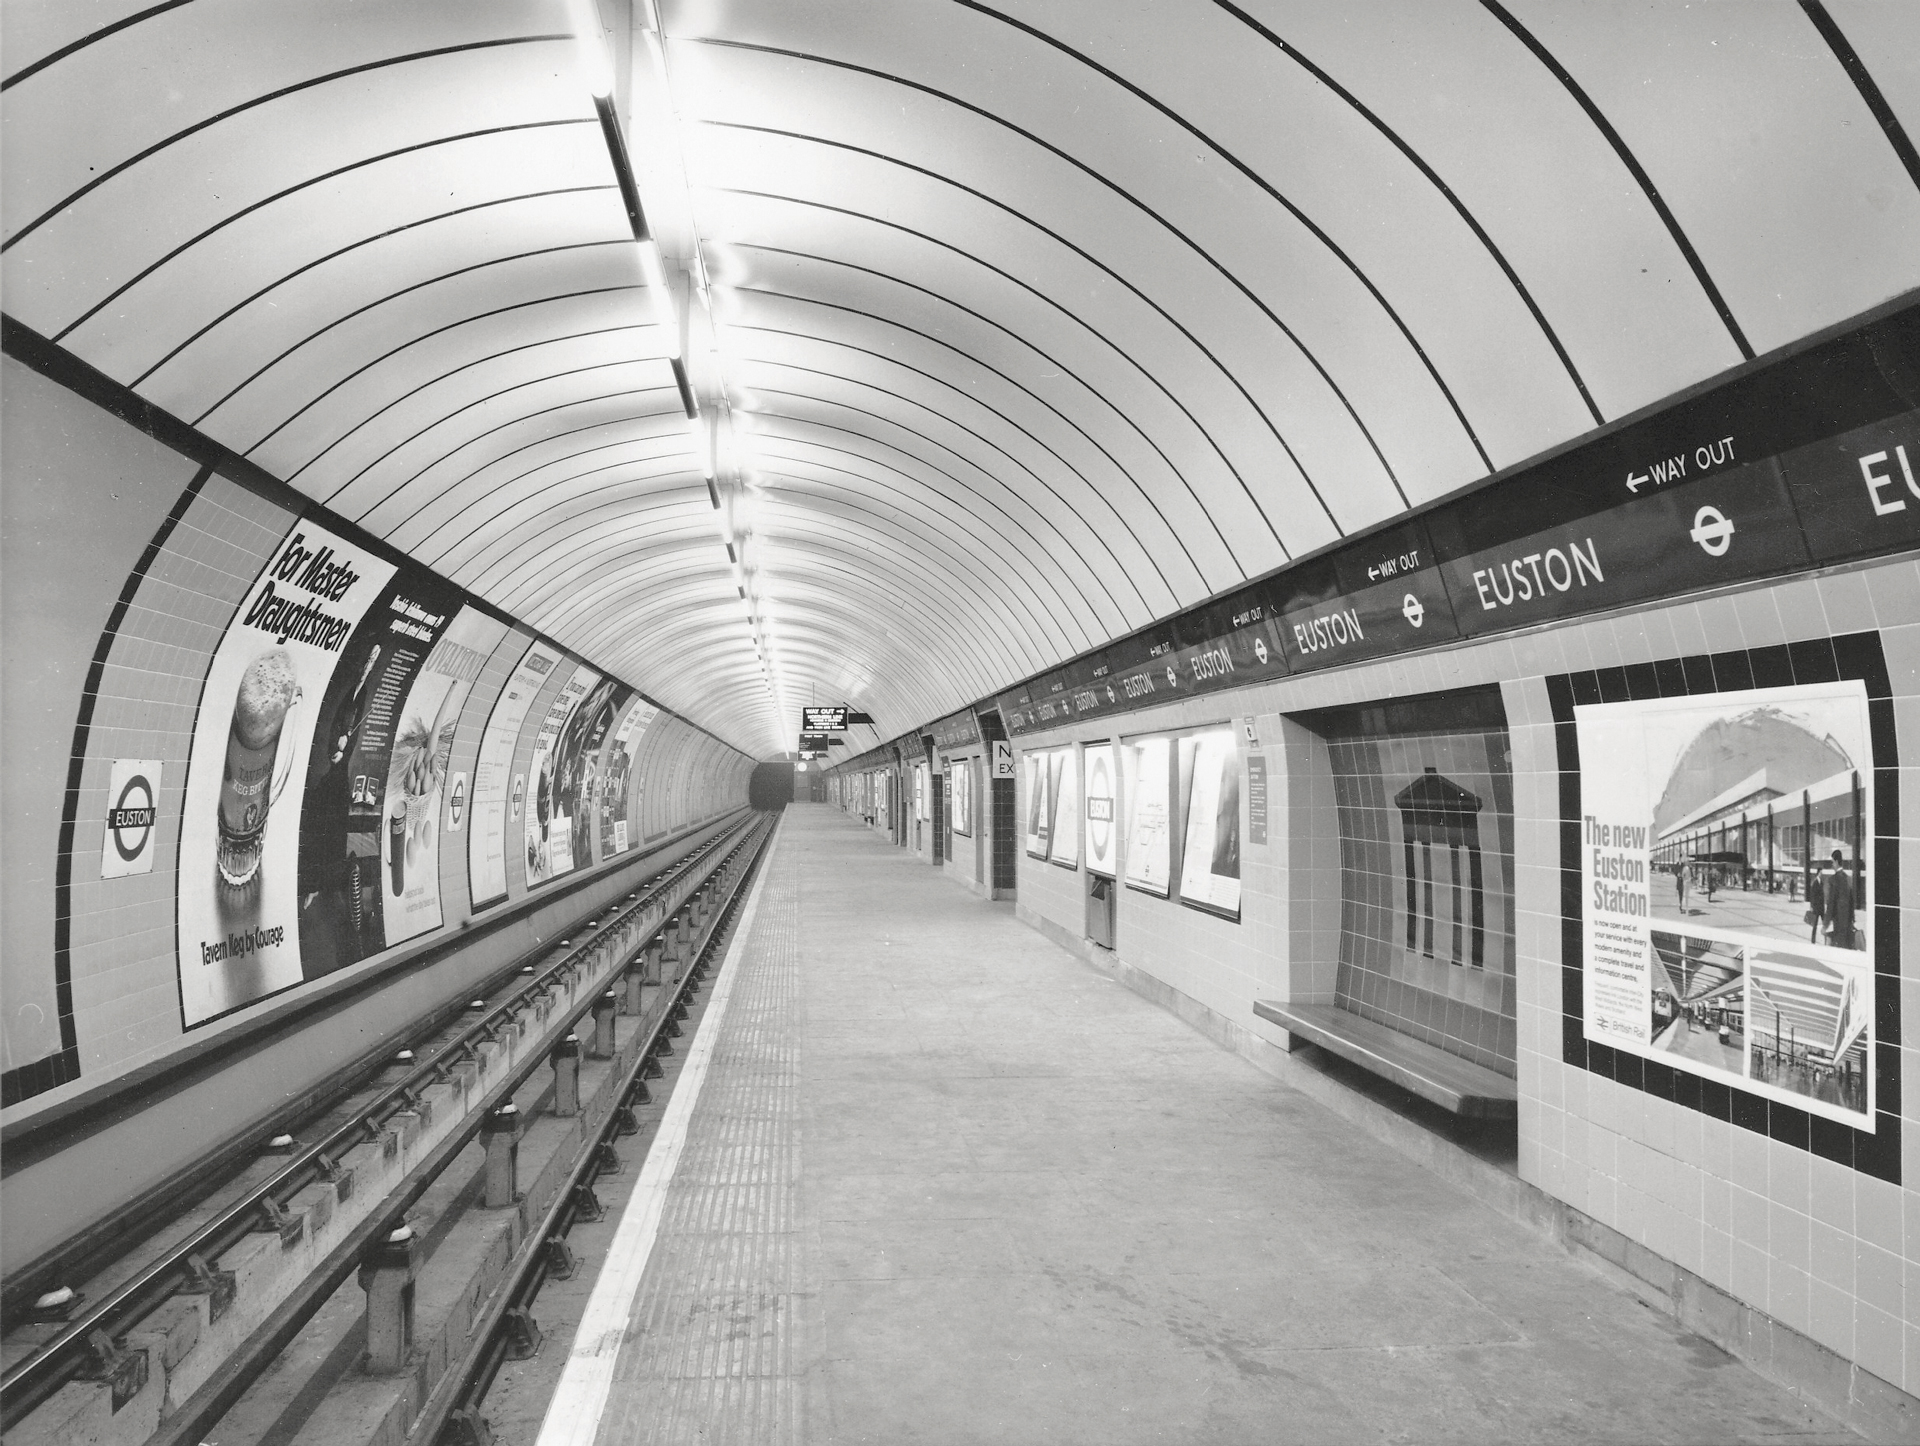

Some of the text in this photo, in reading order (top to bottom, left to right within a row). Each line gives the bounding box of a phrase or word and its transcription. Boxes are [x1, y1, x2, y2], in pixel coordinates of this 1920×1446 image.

[1649, 437, 1735, 485] WAY OUT
[269, 533, 360, 602] For Master
[1378, 551, 1419, 577] WAY OUT
[1473, 538, 1604, 610] EUSTON
[243, 580, 352, 653] Draughtsmen
[1293, 608, 1364, 654] EUSTON
[1190, 647, 1235, 680] EUSTON
[1123, 671, 1156, 698] EUSTON
[1074, 689, 1100, 711] EUSTON
[115, 810, 152, 826] EUSTON
[1584, 815, 1646, 850] The new
[1593, 848, 1644, 884] Euston
[1593, 880, 1647, 918] Station
[1605, 933, 1622, 943] service
[1633, 939, 1647, 948] every
[1610, 922, 1621, 931] open
[1622, 924, 1631, 932] and
[200, 926, 284, 966] Tavern Keg by Courage
[1595, 943, 1642, 959] modern amenity and
[1595, 966, 1621, 979] information
[1598, 956, 1620, 967] complete
[1620, 960, 1634, 969] travel
[1635, 963, 1645, 972] and
[1613, 1020, 1646, 1039] British Rail
